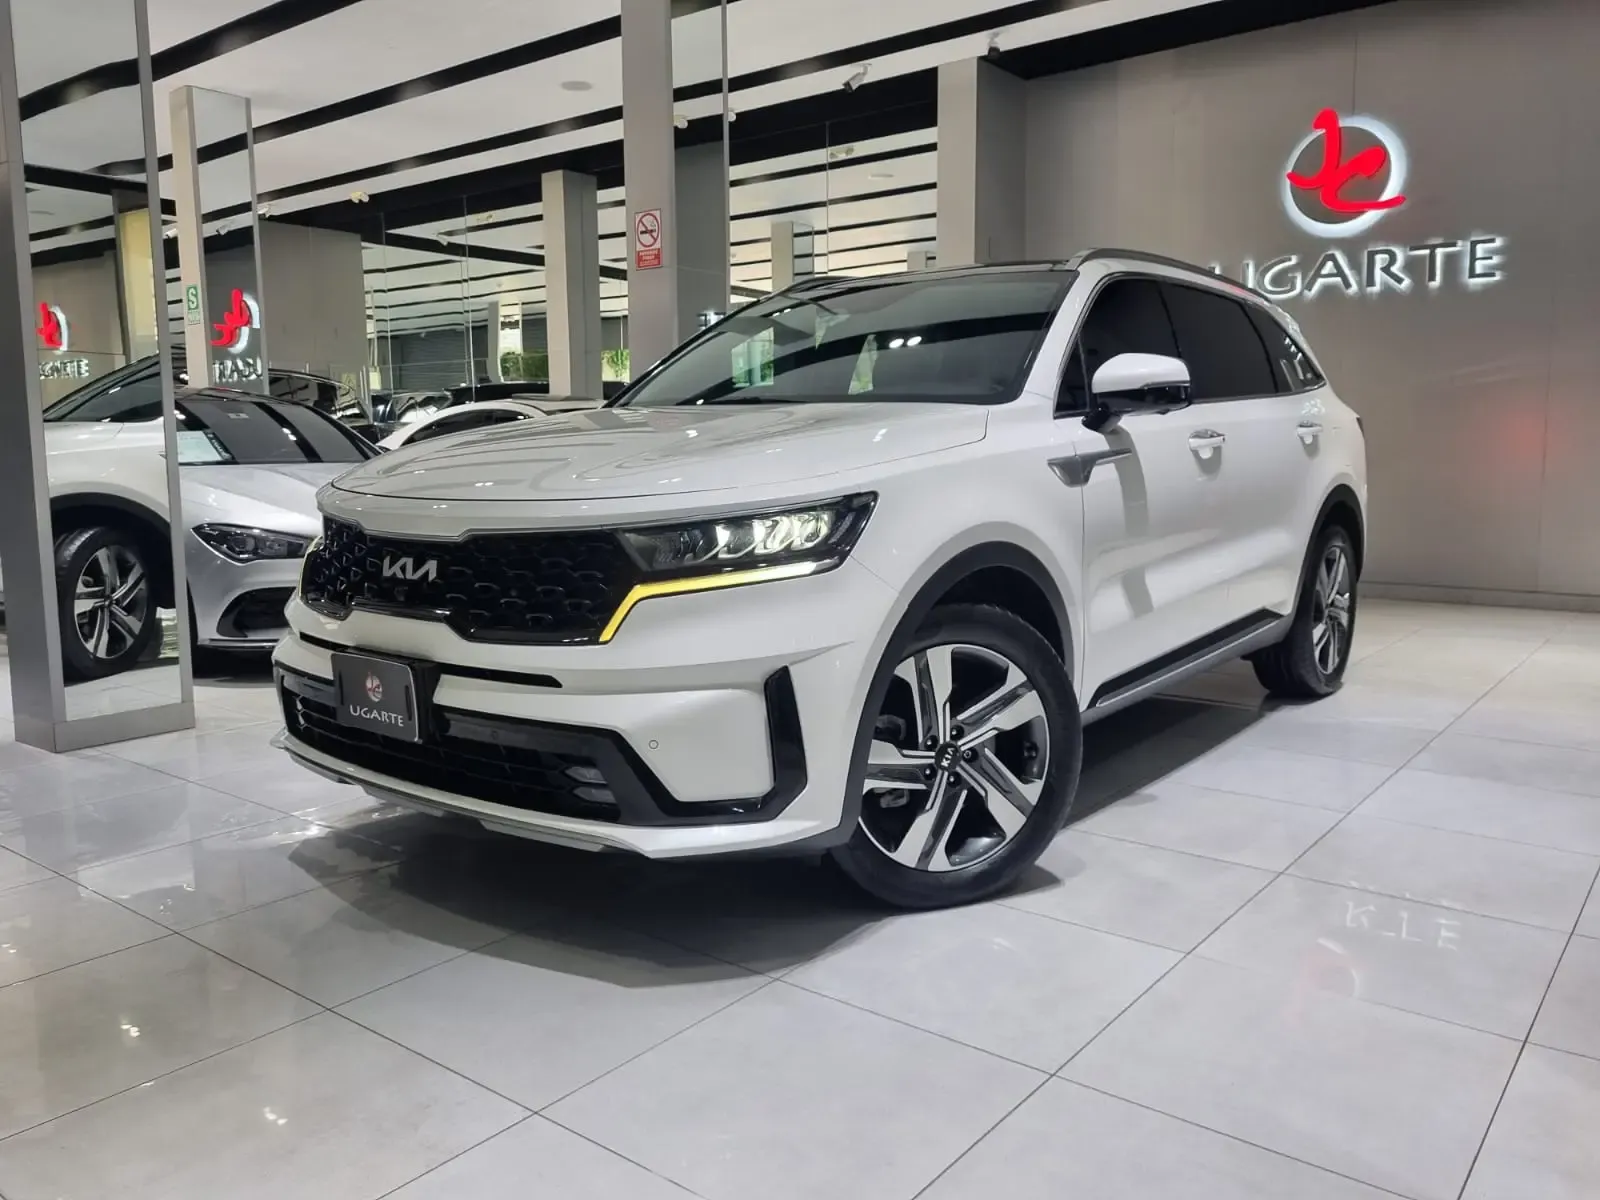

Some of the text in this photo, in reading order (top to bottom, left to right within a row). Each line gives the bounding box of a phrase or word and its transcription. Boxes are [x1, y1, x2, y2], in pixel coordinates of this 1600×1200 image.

[382, 555, 438, 582] KIA
[349, 704, 405, 728] UGARTE
[940, 747, 955, 768] KIA
